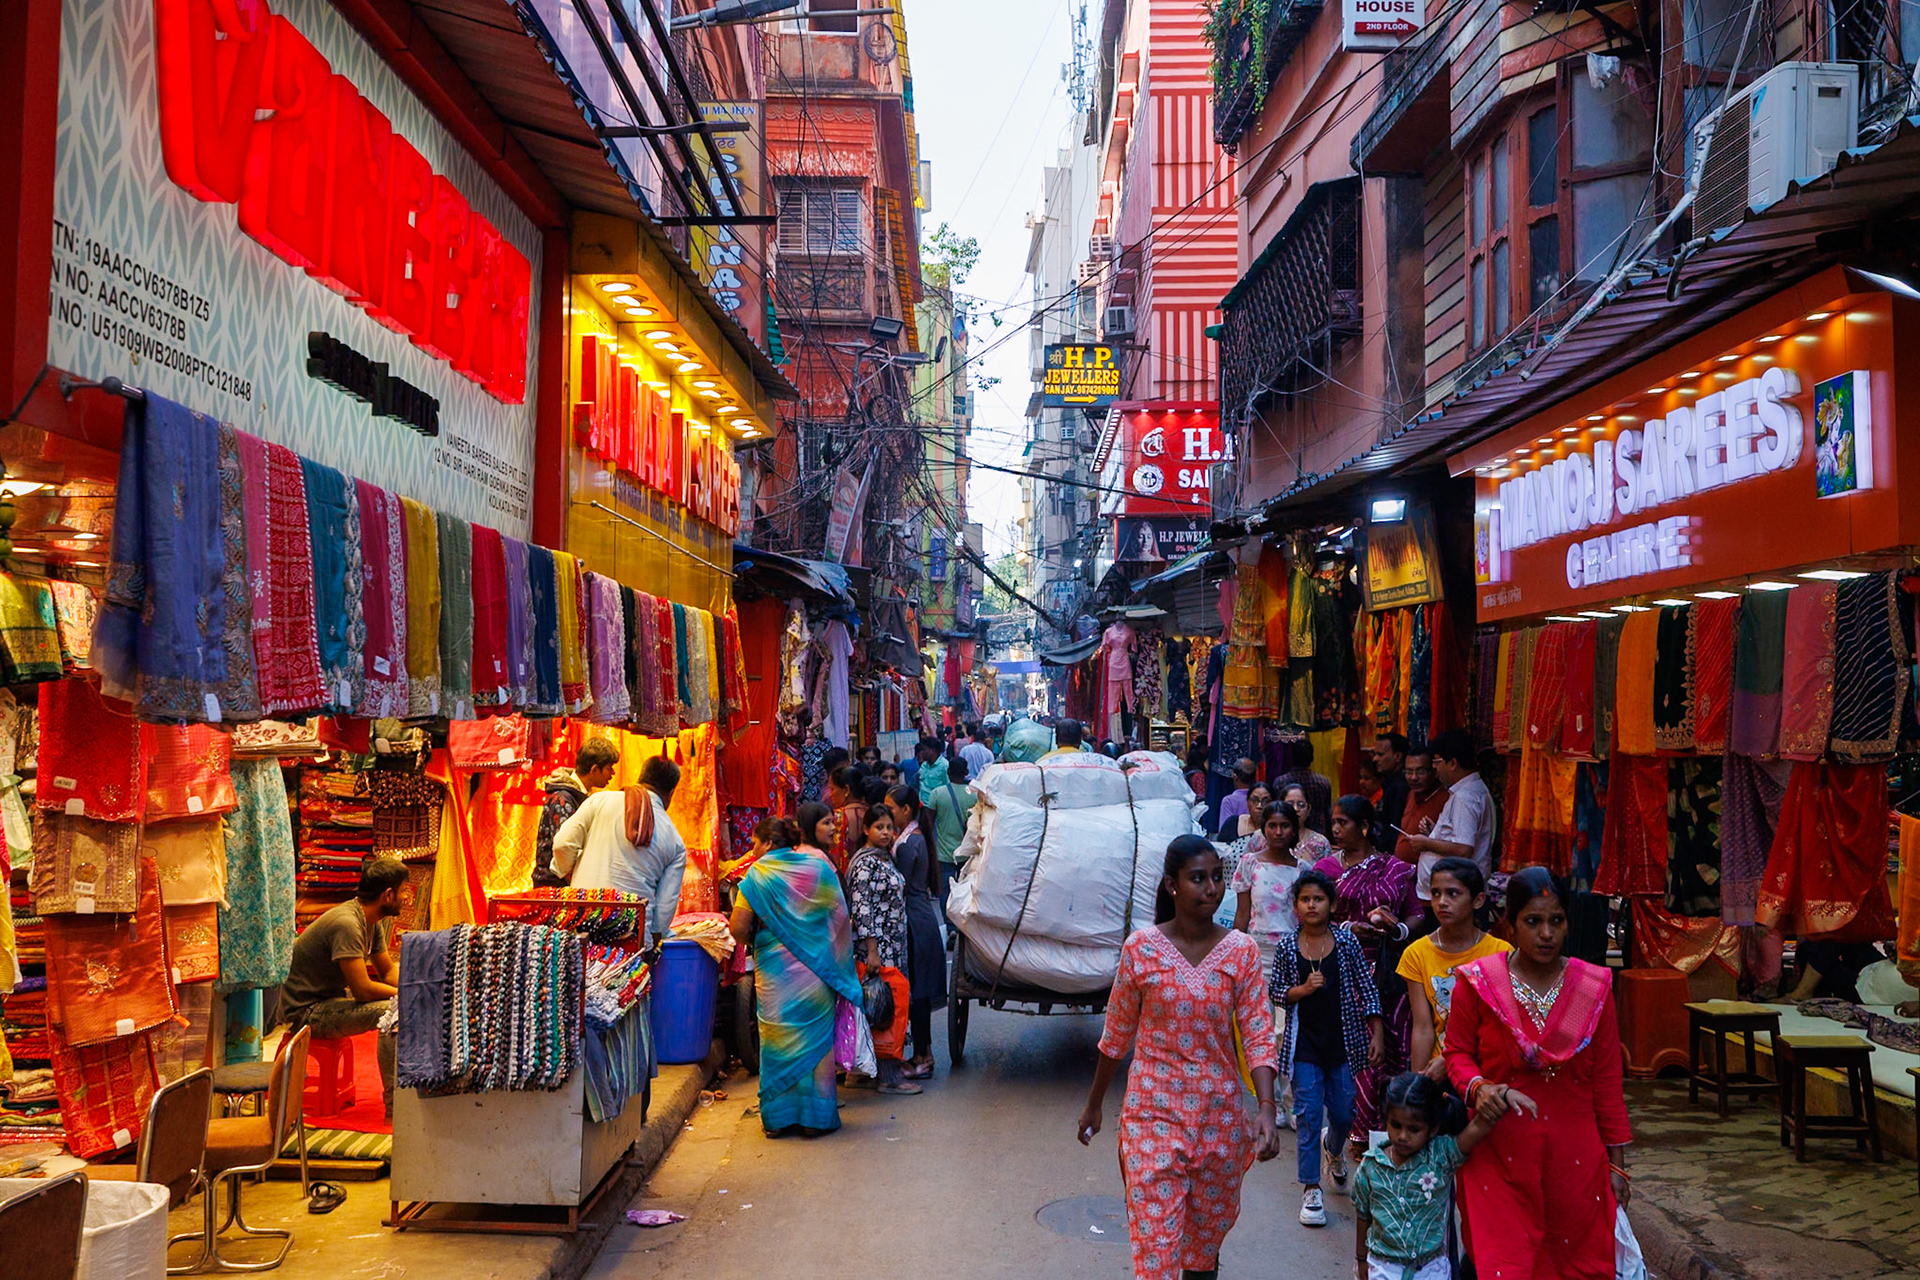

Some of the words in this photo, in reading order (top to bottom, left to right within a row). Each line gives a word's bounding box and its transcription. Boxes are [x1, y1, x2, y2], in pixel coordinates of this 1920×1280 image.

[1356, 1, 1415, 13] HOUSE
[1366, 23, 1382, 31] 2ND
[1384, 23, 1409, 31] FLOOR
[65, 262, 94, 299] NO:
[97, 280, 187, 342] AACCV6378B
[85, 237, 211, 322] 19AACCV6378B1Z5
[58, 296, 87, 332] NO:
[91, 311, 252, 402] U51909WB2008PTC121848
[1044, 368, 1120, 385] JEWELLERS
[1063, 346, 1115, 369] H.P.
[1499, 439, 1615, 552] MANOJ
[1614, 366, 1804, 516] SAREES
[1565, 515, 1692, 590] CENTRE
